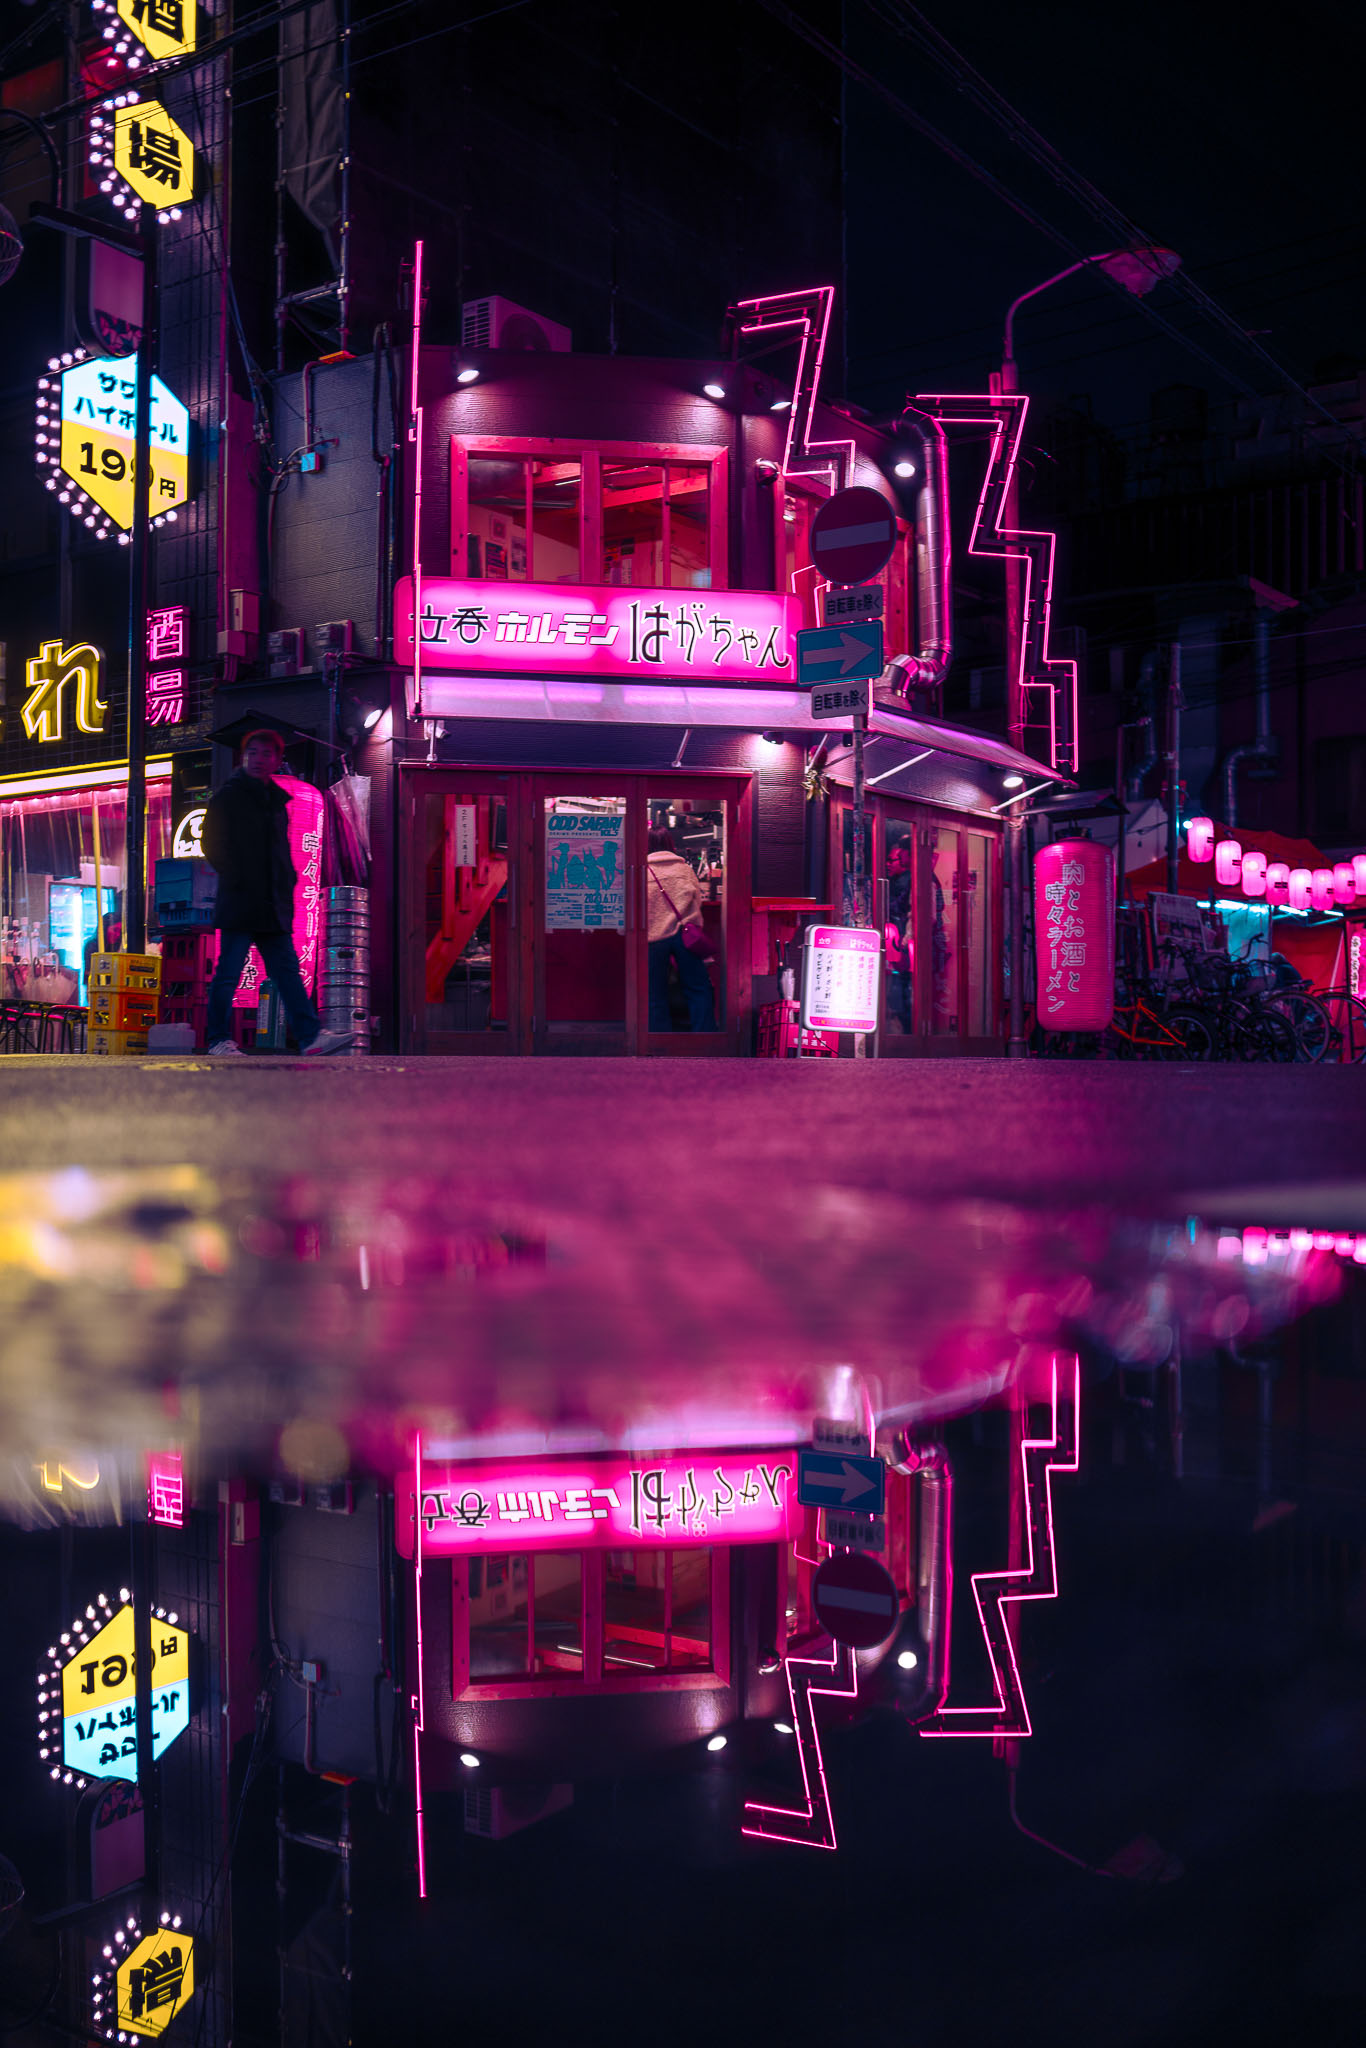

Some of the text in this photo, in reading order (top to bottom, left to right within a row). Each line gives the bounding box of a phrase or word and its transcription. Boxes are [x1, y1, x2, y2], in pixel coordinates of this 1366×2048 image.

[129, 119, 181, 190] 場
[409, 600, 792, 668] 立呑 ホルモン はがちゃん
[827, 593, 880, 616] 自転車を除く
[20, 639, 108, 743] れ
[814, 689, 866, 711] 自転車を除く
[548, 815, 623, 831] ODD SAFARI
[1045, 881, 1067, 1013] 時々ラーメン
[1061, 860, 1086, 993] 肉とお酒と
